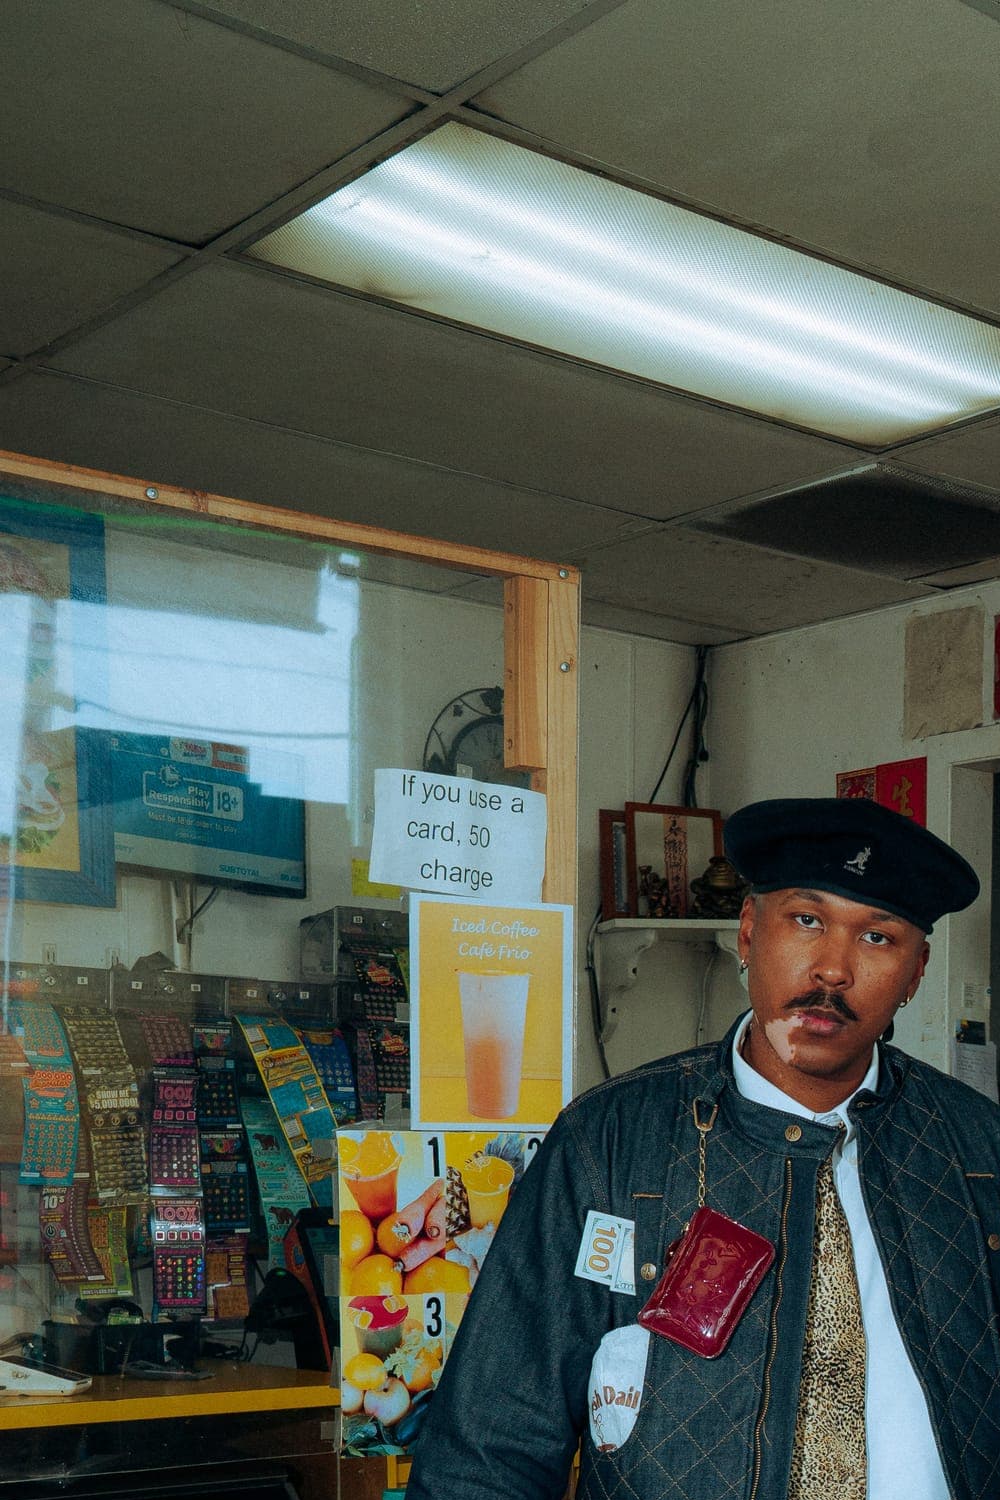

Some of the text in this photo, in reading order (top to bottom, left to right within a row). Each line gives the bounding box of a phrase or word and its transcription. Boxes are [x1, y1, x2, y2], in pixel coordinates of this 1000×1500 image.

[149, 791, 210, 811] Responsibly
[187, 785, 210, 798] Play
[216, 791, 239, 812] 18+
[402, 774, 524, 813] If you use a
[407, 820, 491, 849] card, 50
[420, 858, 493, 891] charge
[450, 917, 540, 940] Iced Coffee
[457, 942, 496, 960] Café
[427, 1136, 440, 1177] 1
[157, 1206, 198, 1221] 100X
[588, 1226, 617, 1273] 100
[426, 1296, 442, 1337] 3
[603, 1385, 641, 1409] Dail
